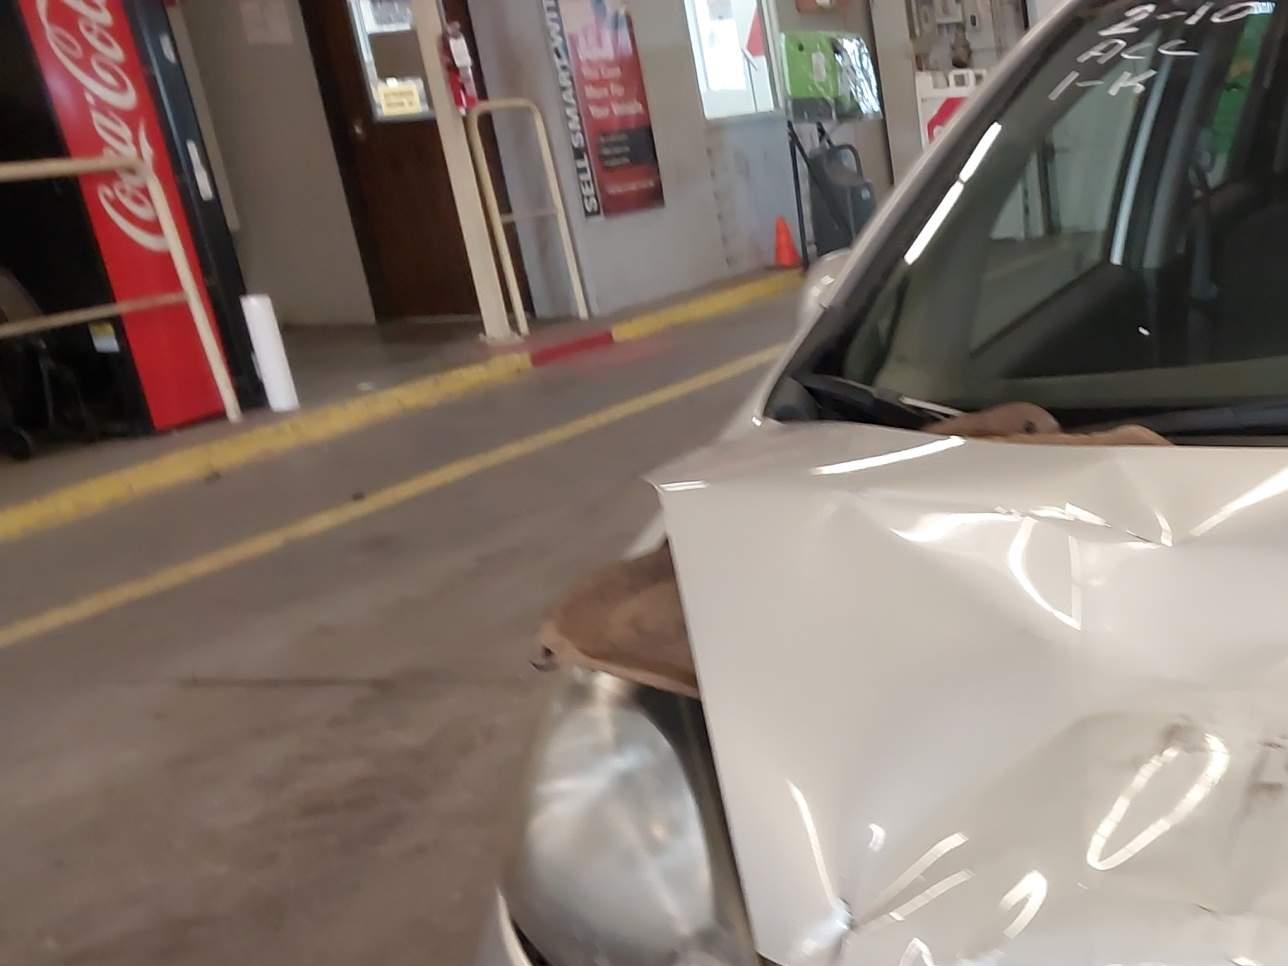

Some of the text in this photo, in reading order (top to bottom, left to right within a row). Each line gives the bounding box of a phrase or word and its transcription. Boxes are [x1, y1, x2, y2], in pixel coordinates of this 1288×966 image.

[1098, 2, 1264, 36] 2-10
[36, 0, 170, 252] Coca-Col
[552, 50, 586, 149] SMART
[574, 151, 599, 213] SELL
